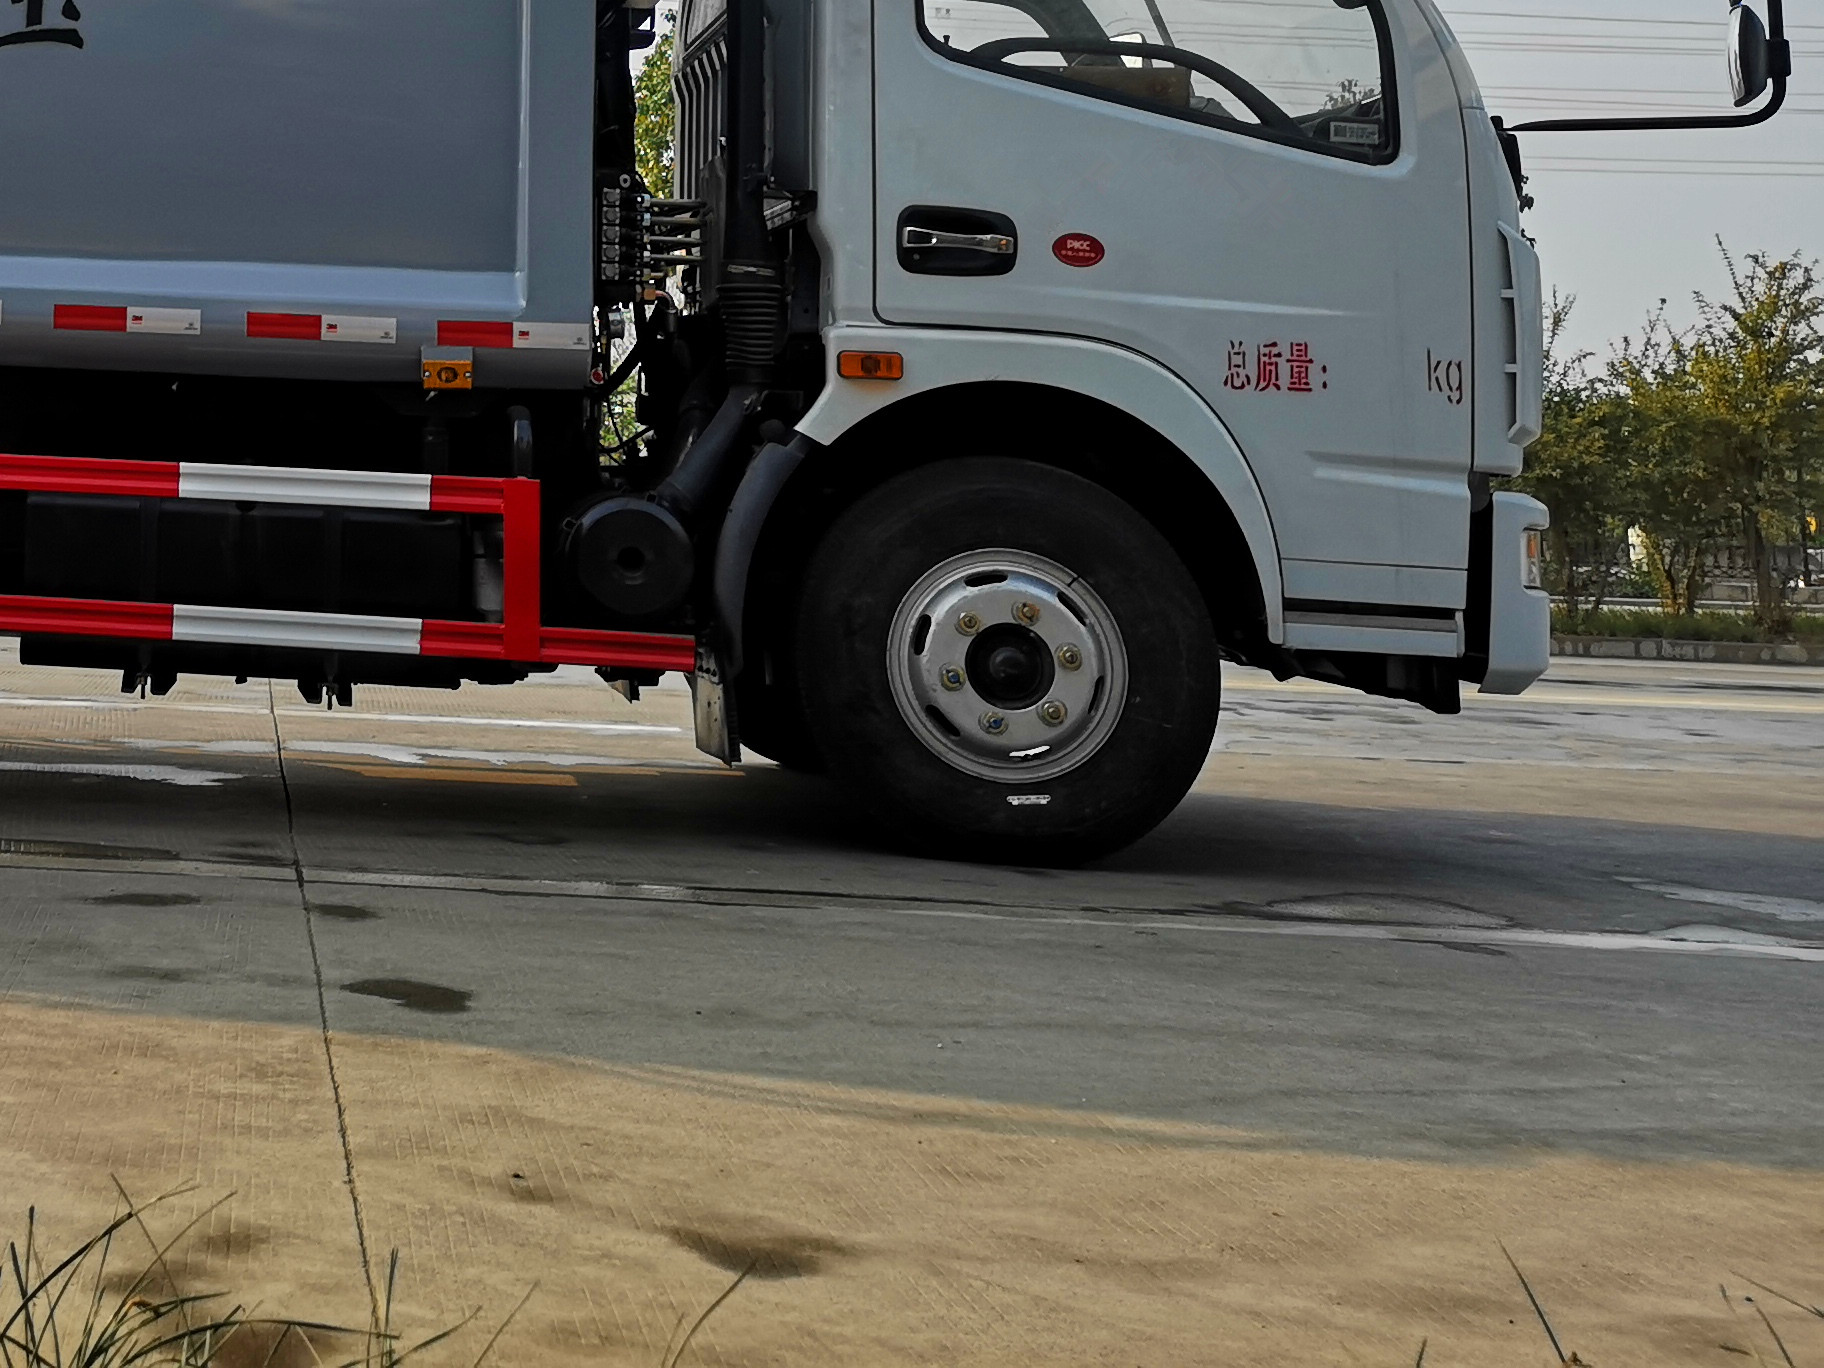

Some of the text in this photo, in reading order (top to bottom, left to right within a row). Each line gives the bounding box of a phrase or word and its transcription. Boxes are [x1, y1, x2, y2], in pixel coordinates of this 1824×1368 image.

[1223, 340, 1328, 393] 总质量:
[1426, 346, 1464, 406] kg
